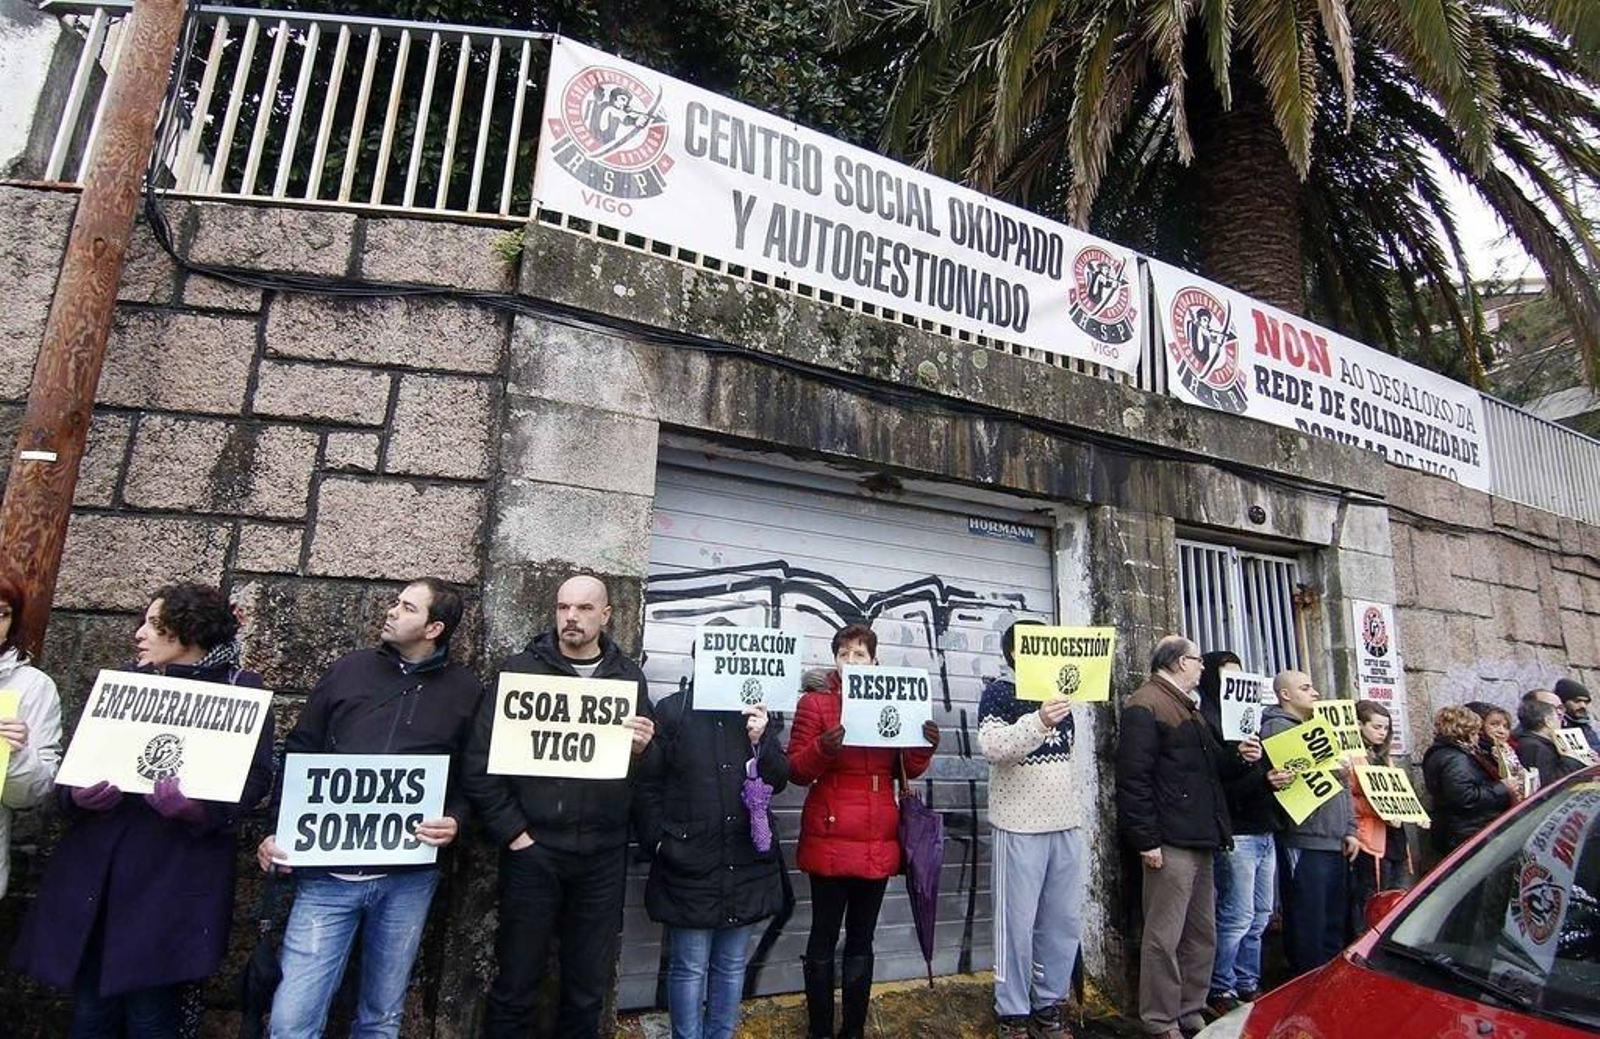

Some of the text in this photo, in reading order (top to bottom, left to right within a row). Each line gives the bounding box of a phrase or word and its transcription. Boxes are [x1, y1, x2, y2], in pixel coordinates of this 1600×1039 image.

[581, 189, 633, 218] VIGO
[684, 101, 822, 196] CENTRO
[834, 154, 941, 238] SOCIAL
[948, 196, 1064, 281] OKUPADO
[732, 189, 758, 250] Y
[762, 202, 1029, 334] AUTOGESTIONADO
[1090, 341, 1120, 360] VIGO
[1251, 308, 1333, 378] NON
[1340, 357, 1365, 390] AO
[1367, 369, 1454, 424] DESALOXO
[1455, 403, 1477, 435] DA
[1253, 364, 1314, 411] REDE
[1319, 385, 1346, 421] DE
[1350, 397, 1481, 467] SOLIDARIEDADE
[703, 631, 797, 655] EDUCACIÓN
[1020, 632, 1110, 658] AUTOGESTIÓN
[714, 652, 785, 677] PÚBLICA
[848, 674, 929, 702] RESPETO
[91, 683, 260, 735] EMPODERAMIENTO
[504, 690, 630, 726] CSOA RSP
[531, 730, 596, 763] VIGO
[307, 768, 426, 804] TODXS
[1366, 772, 1406, 792] NO AL
[294, 813, 425, 852] SOMOS
